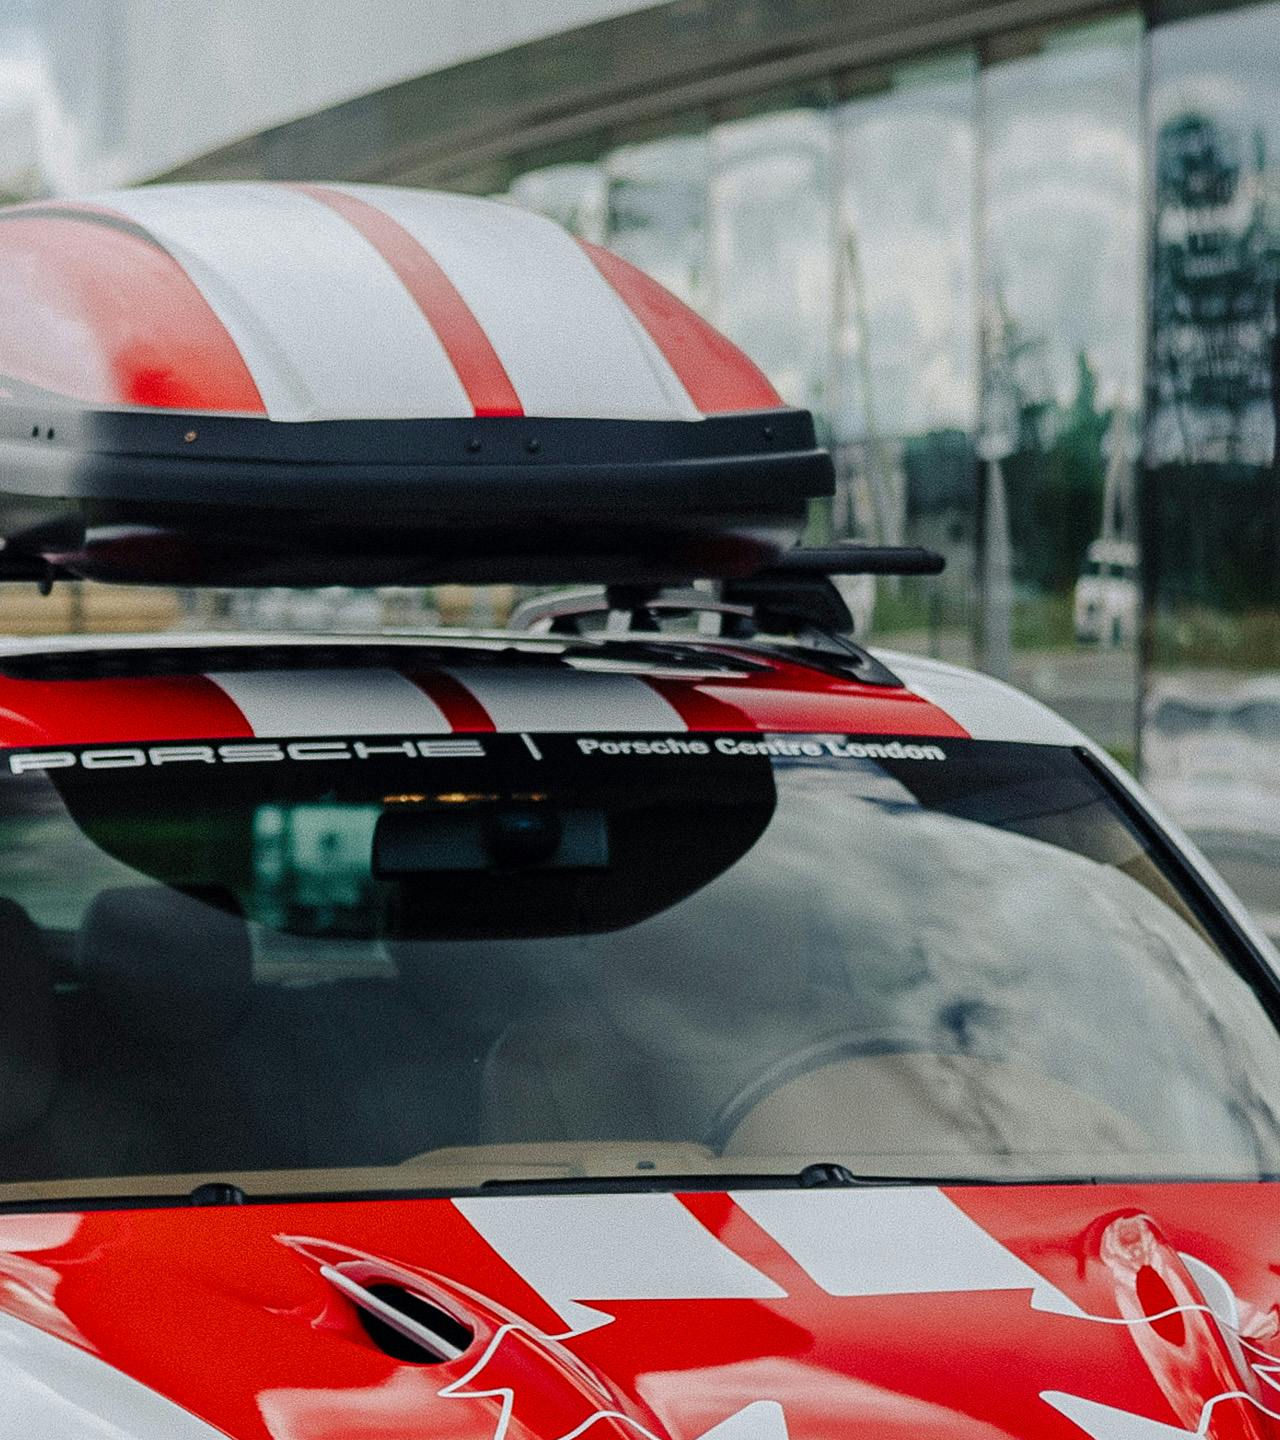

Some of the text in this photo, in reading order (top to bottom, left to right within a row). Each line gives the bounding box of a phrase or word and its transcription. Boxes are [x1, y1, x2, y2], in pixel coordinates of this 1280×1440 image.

[9, 738, 947, 774] PORSCHE Porsche Centre London
